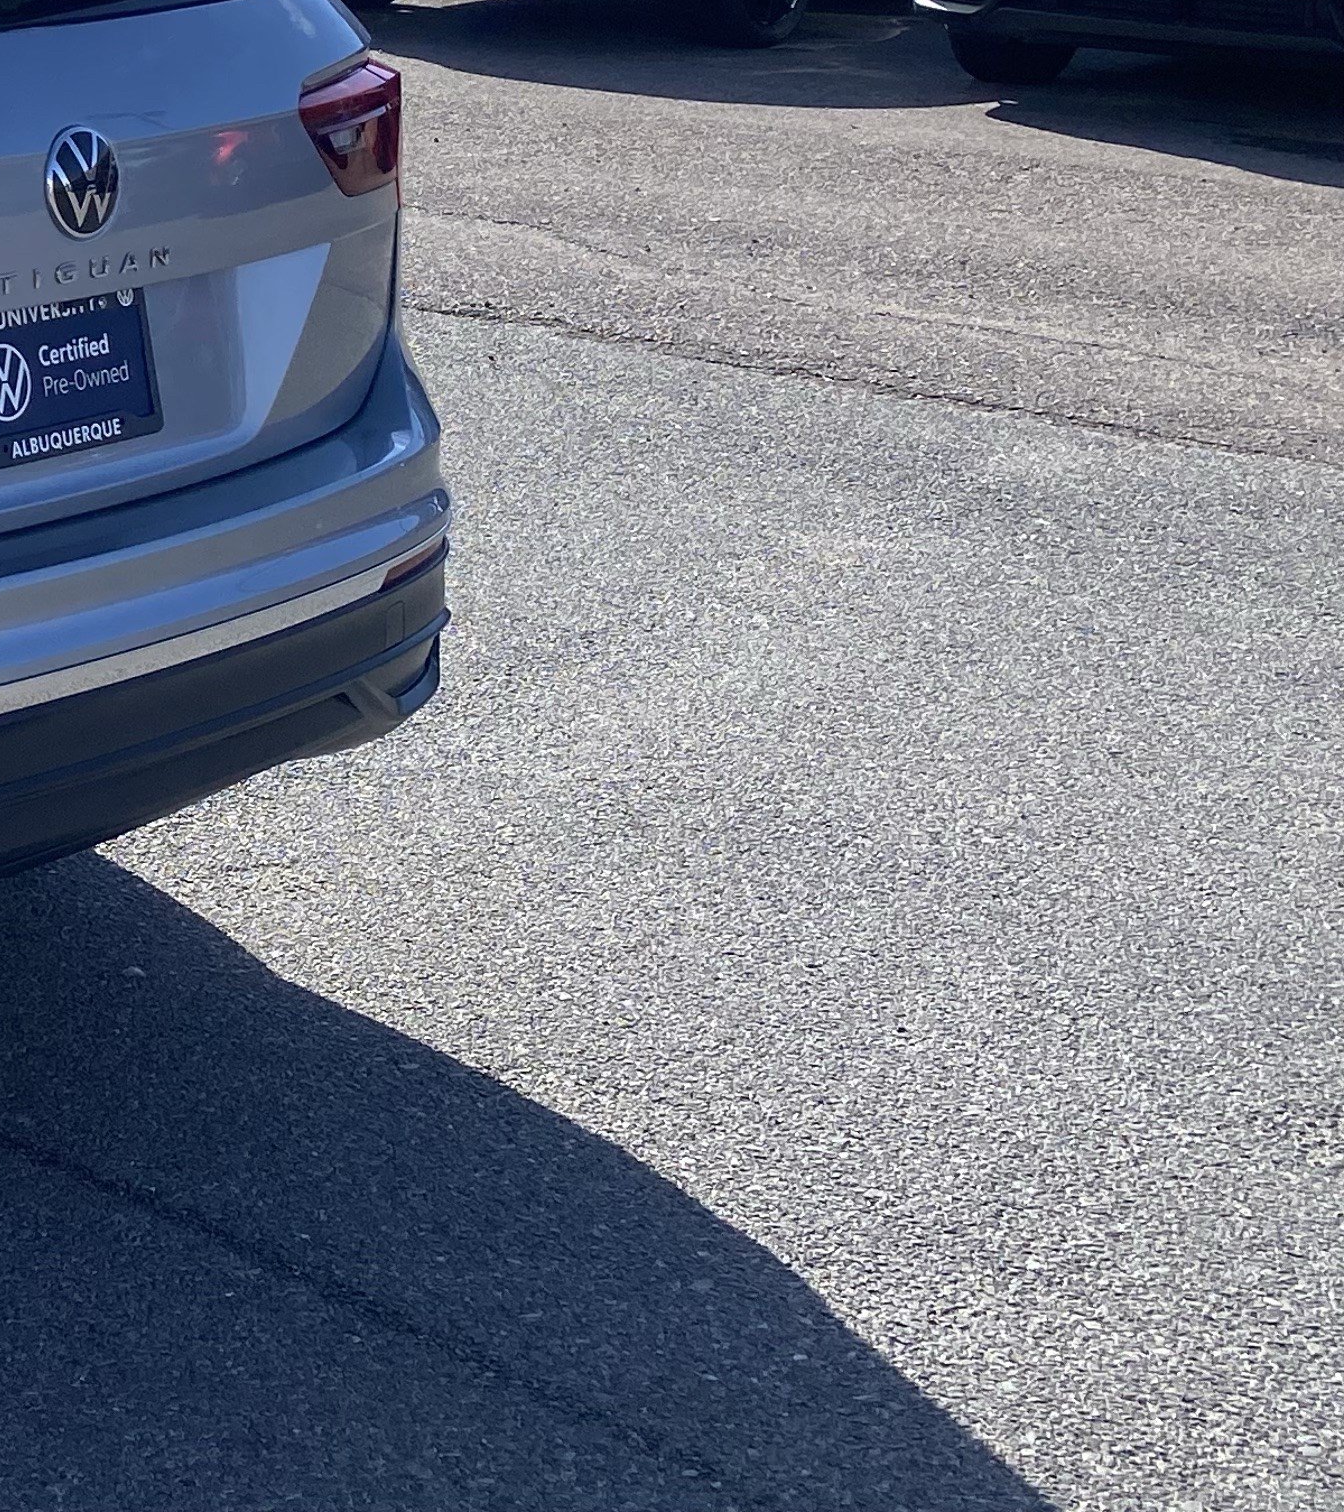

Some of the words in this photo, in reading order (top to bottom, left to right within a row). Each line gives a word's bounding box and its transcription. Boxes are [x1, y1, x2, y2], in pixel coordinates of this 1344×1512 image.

[38, 333, 110, 366] Certified
[43, 360, 130, 397] Pre-Owned
[12, 418, 122, 459] ALBUQUERQUE
